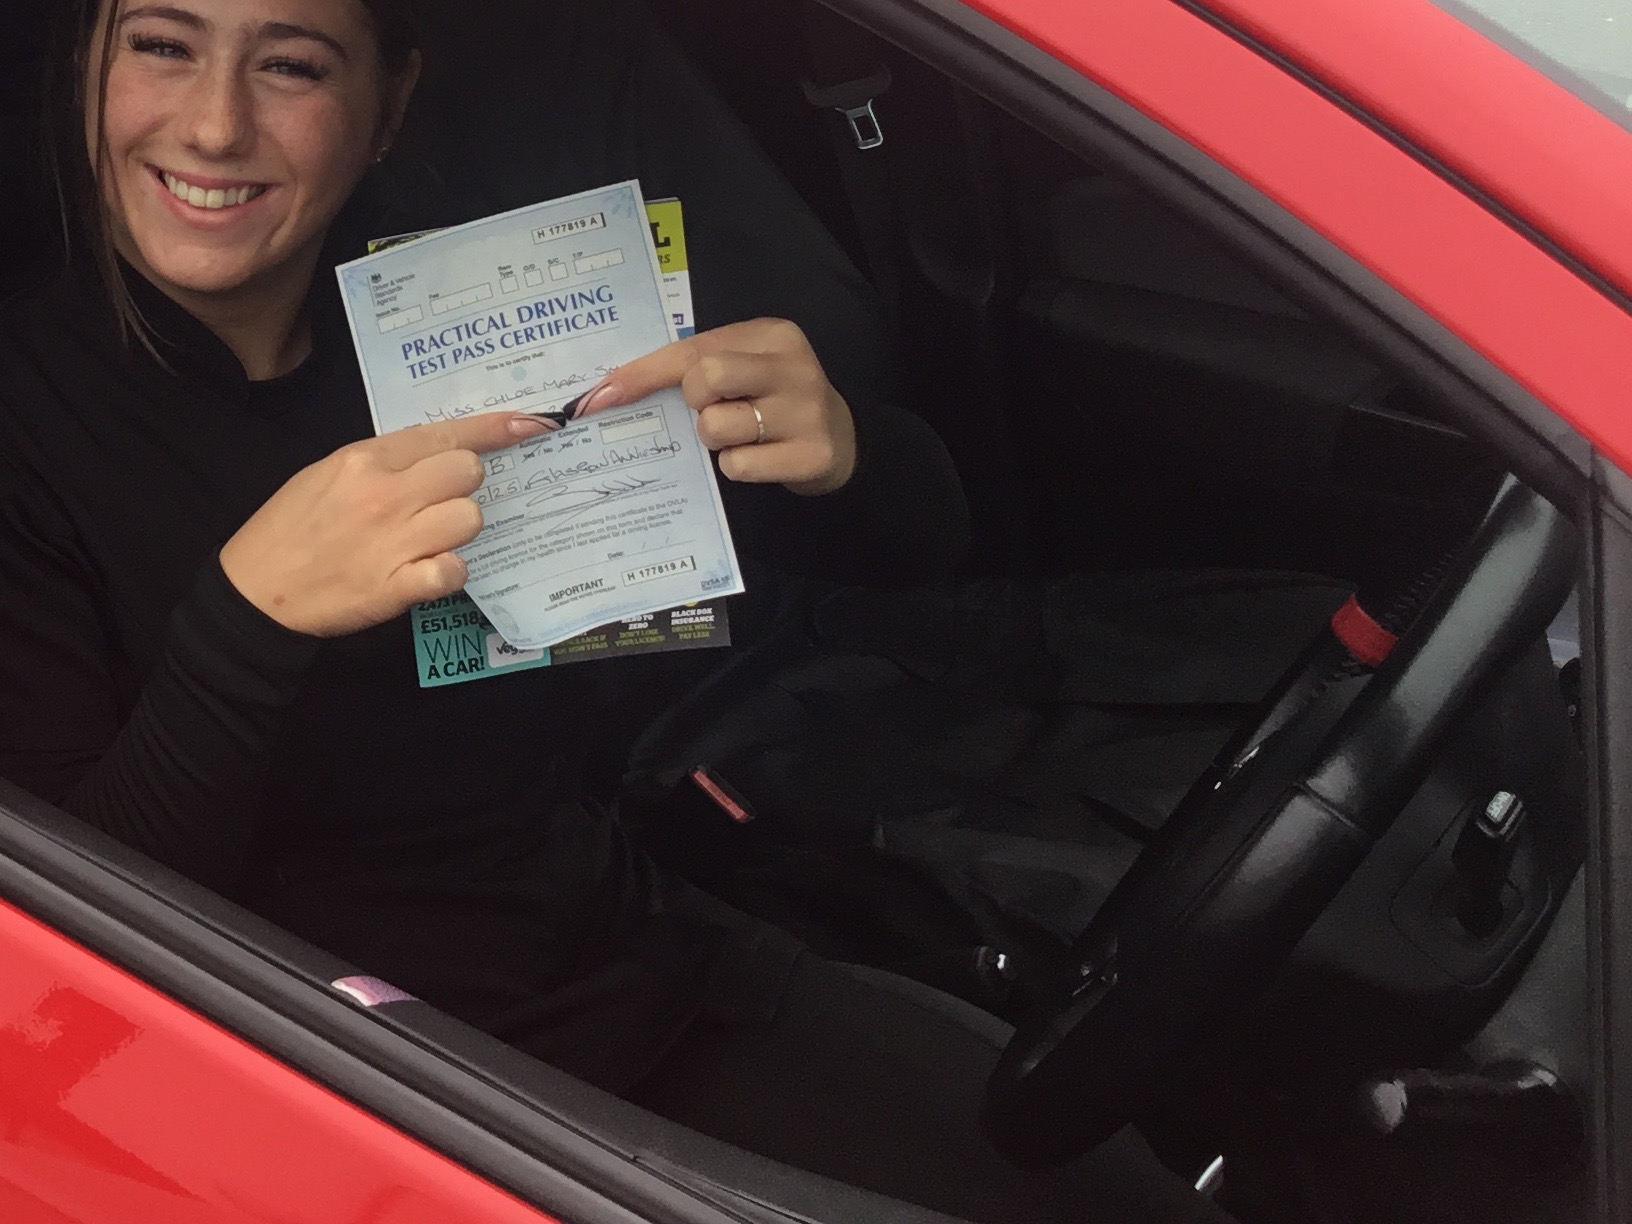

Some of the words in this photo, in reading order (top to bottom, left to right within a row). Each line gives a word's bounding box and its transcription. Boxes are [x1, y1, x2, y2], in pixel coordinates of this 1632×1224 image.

[537, 230, 545, 238] H
[549, 220, 586, 234] 177819
[590, 217, 597, 225] A
[377, 295, 396, 306] Agency
[402, 313, 510, 359] PRACTICAL
[517, 285, 612, 322] DRIVING
[407, 353, 445, 378] TEST
[452, 338, 494, 363] PASS
[500, 306, 617, 348] CERTIFICATE
[513, 355, 530, 364] certify
[598, 416, 634, 427] Restriction
[635, 411, 653, 419] Code
[558, 426, 588, 438] Extended
[496, 514, 524, 526] Examiner
[549, 536, 574, 546] category
[647, 512, 669, 521] declare
[478, 545, 511, 560] Declaration
[618, 507, 647, 518] certificate
[627, 572, 635, 580] H
[639, 563, 676, 577] 177819
[680, 560, 687, 568] A
[549, 579, 605, 601] IMPORTANT
[421, 611, 479, 633] £51,518
[671, 609, 696, 617] BLACK
[671, 615, 714, 625] INSURANCE
[424, 631, 481, 662] WIN
[428, 665, 441, 679] A
[443, 656, 484, 676] CAR!
